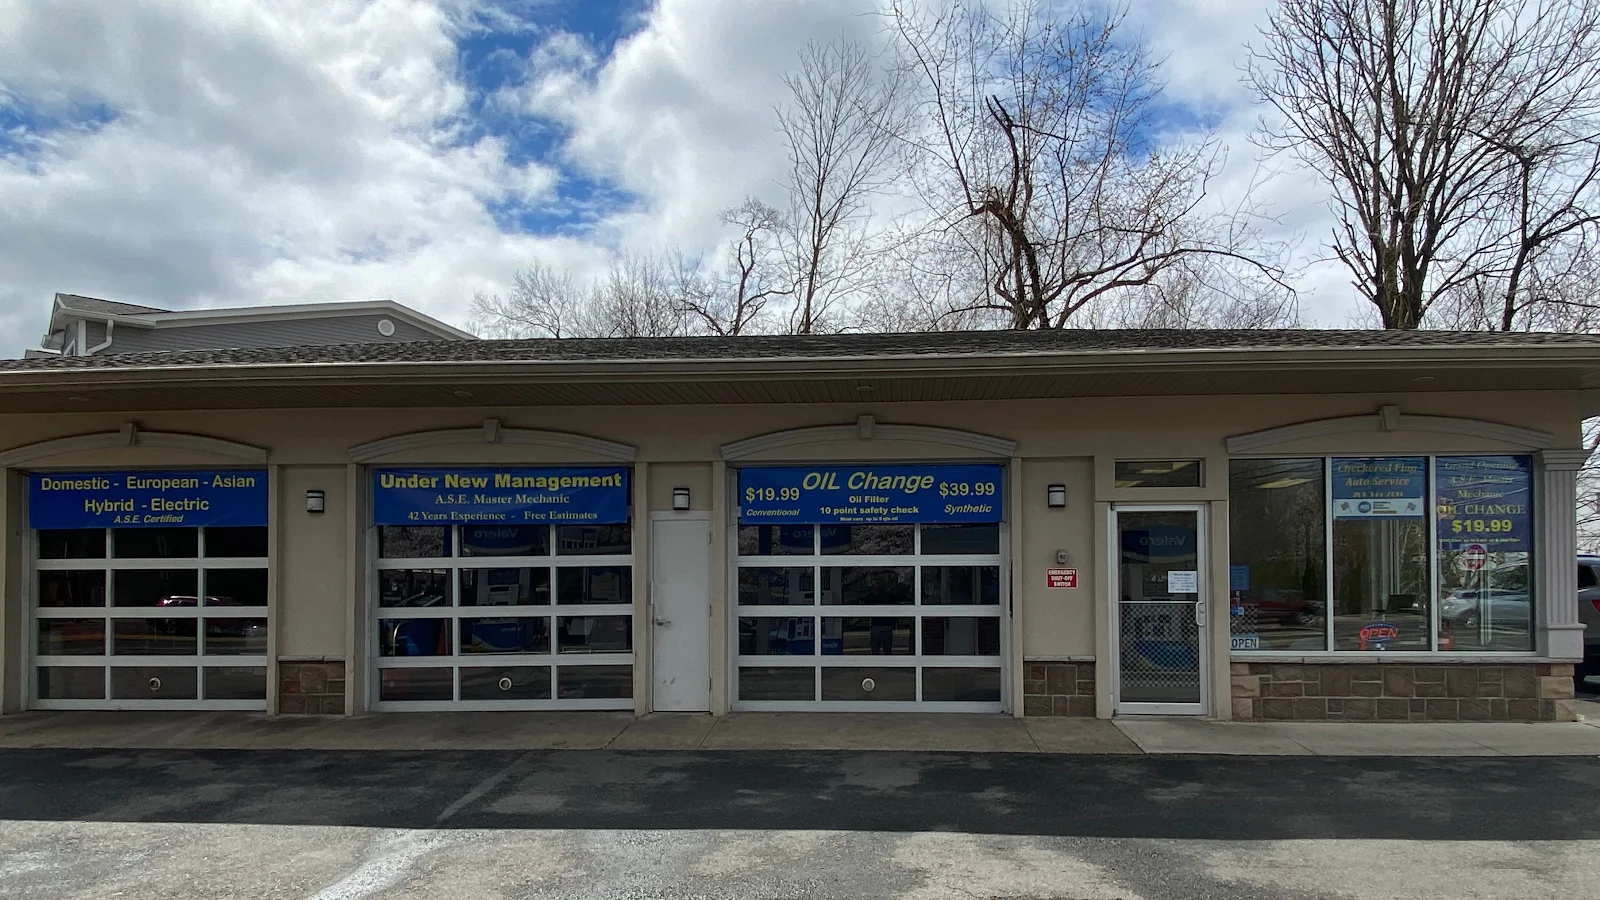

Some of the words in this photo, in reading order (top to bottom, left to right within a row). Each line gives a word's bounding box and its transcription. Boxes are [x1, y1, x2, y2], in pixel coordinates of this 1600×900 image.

[1338, 462, 1392, 474] Checkered
[1394, 462, 1418, 475] Flag
[41, 477, 110, 491] Domestic
[127, 476, 199, 492] European
[212, 474, 255, 488] Asian
[380, 473, 438, 489] Under
[445, 474, 488, 488] New
[494, 472, 622, 491] Management
[802, 472, 840, 491] OIL
[847, 471, 935, 494] Change
[1345, 477, 1370, 487] Auto
[1371, 477, 1411, 487] Service
[745, 487, 800, 504] $19.99
[939, 481, 995, 499] $39.99
[435, 494, 470, 504] A.S.E.
[473, 494, 513, 504] Master
[515, 493, 570, 504] Mechanic
[849, 495, 862, 504] Oil
[864, 495, 889, 504] Filter
[84, 498, 134, 515] Hybrid
[151, 497, 210, 511] Electric
[819, 506, 831, 514] 10
[833, 506, 858, 516] point
[859, 506, 889, 516] safety
[890, 505, 919, 514] check
[943, 503, 993, 515] Synthetic
[1464, 504, 1526, 515] CHANGE
[408, 511, 419, 520] 42
[421, 511, 448, 521] Years
[451, 511, 506, 522] Experience
[524, 510, 547, 520] Free
[550, 510, 598, 520] Estimates
[746, 508, 800, 517] Conventional
[114, 515, 141, 524] A.S.E.
[143, 514, 184, 523] Certified
[1452, 519, 1513, 533] $19.99
[1360, 628, 1399, 639] OPEN
[1231, 638, 1257, 648] OPEN
